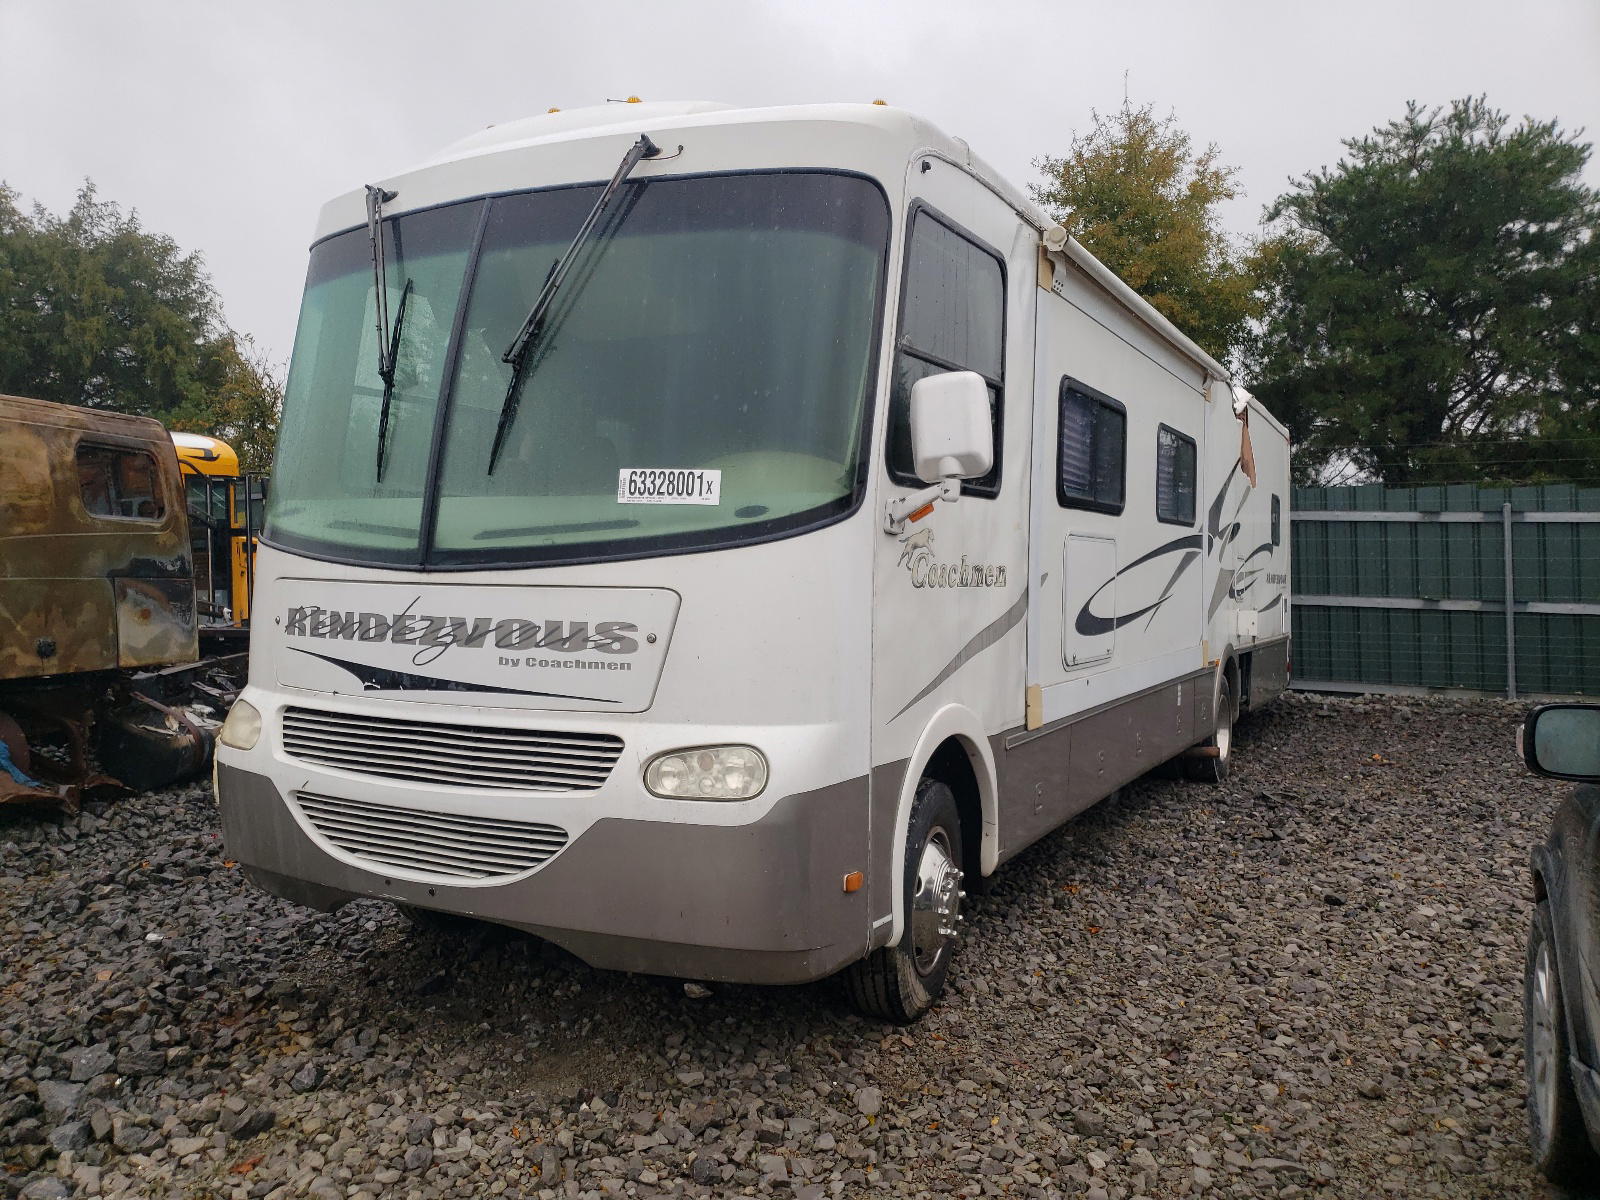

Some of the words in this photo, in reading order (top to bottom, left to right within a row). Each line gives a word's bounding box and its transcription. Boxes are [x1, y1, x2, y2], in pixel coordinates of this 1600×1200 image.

[628, 470, 704, 497] 63328001
[911, 552, 1007, 589] Coachmen
[286, 607, 639, 655] RENDEZVOUS
[498, 656, 521, 668] by
[525, 657, 632, 671] Coachmen
